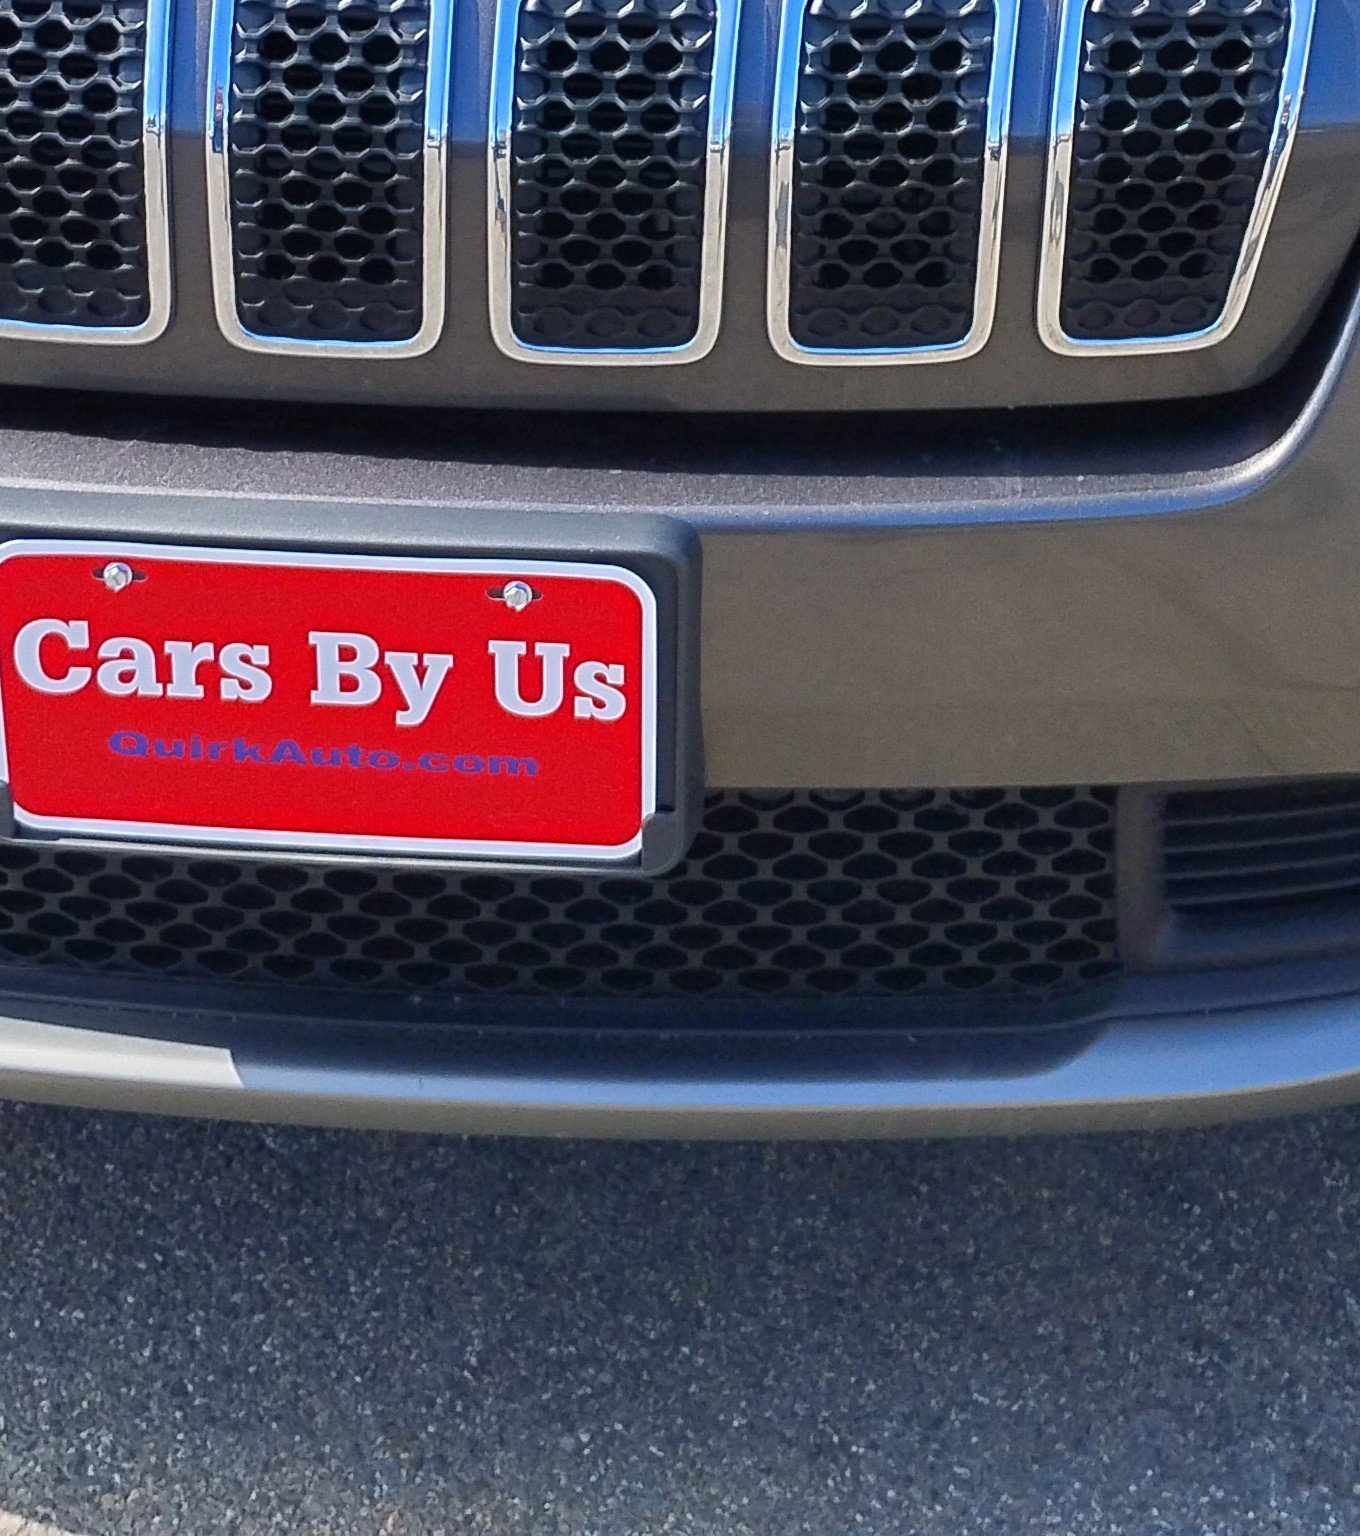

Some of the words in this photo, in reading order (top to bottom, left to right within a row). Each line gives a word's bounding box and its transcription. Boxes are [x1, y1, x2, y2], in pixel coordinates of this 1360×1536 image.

[13, 617, 273, 703] Cars
[307, 629, 453, 727] By
[488, 639, 627, 722] Us
[107, 729, 539, 776] QuirkAuto.com
